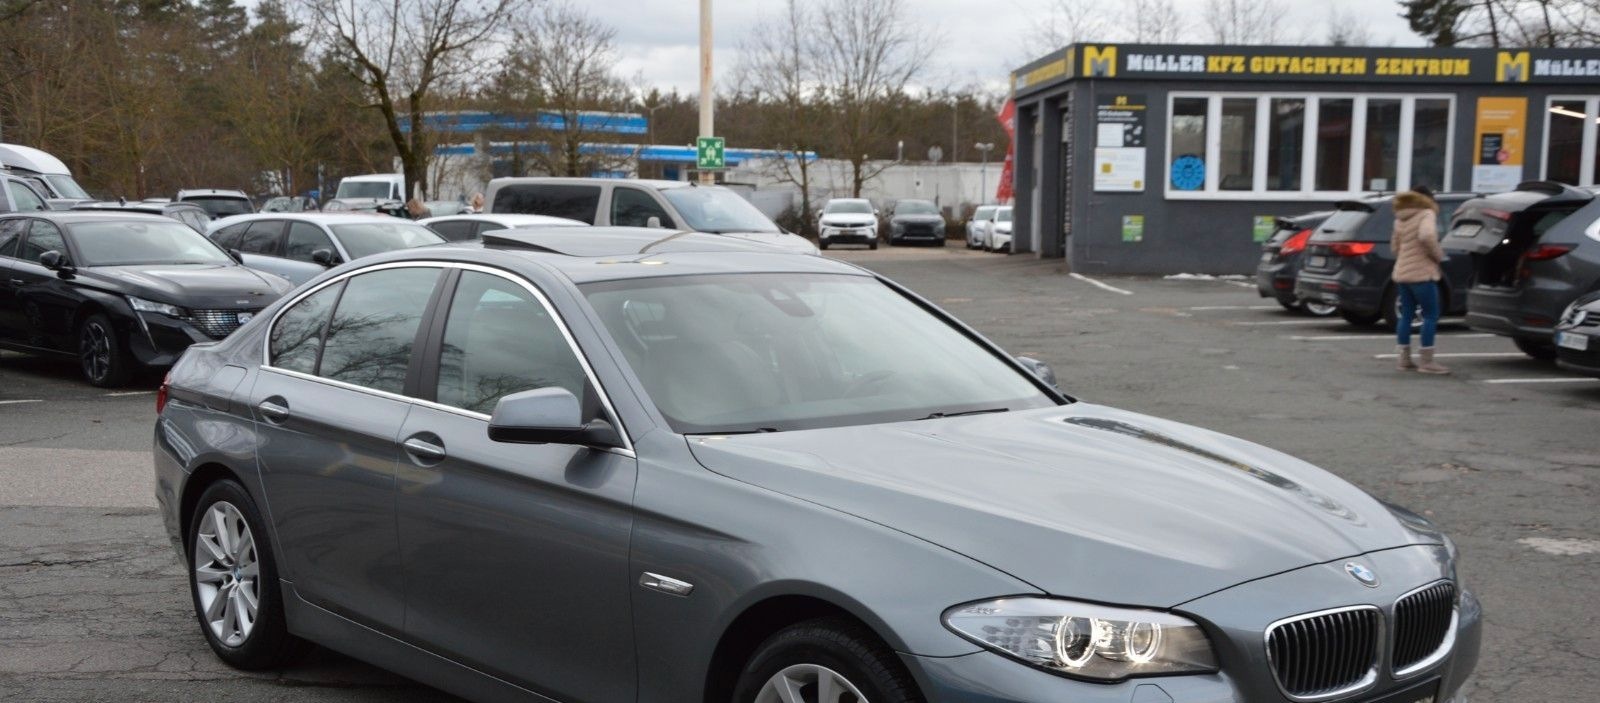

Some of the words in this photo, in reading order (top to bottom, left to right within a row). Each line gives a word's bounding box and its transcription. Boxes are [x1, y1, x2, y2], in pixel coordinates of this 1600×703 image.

[1207, 55, 1245, 73] KFZ
[1250, 56, 1367, 74] GUTACHTEN
[1375, 58, 1470, 75] ZENTRUM
[1535, 59, 1600, 76] MÜLLE
